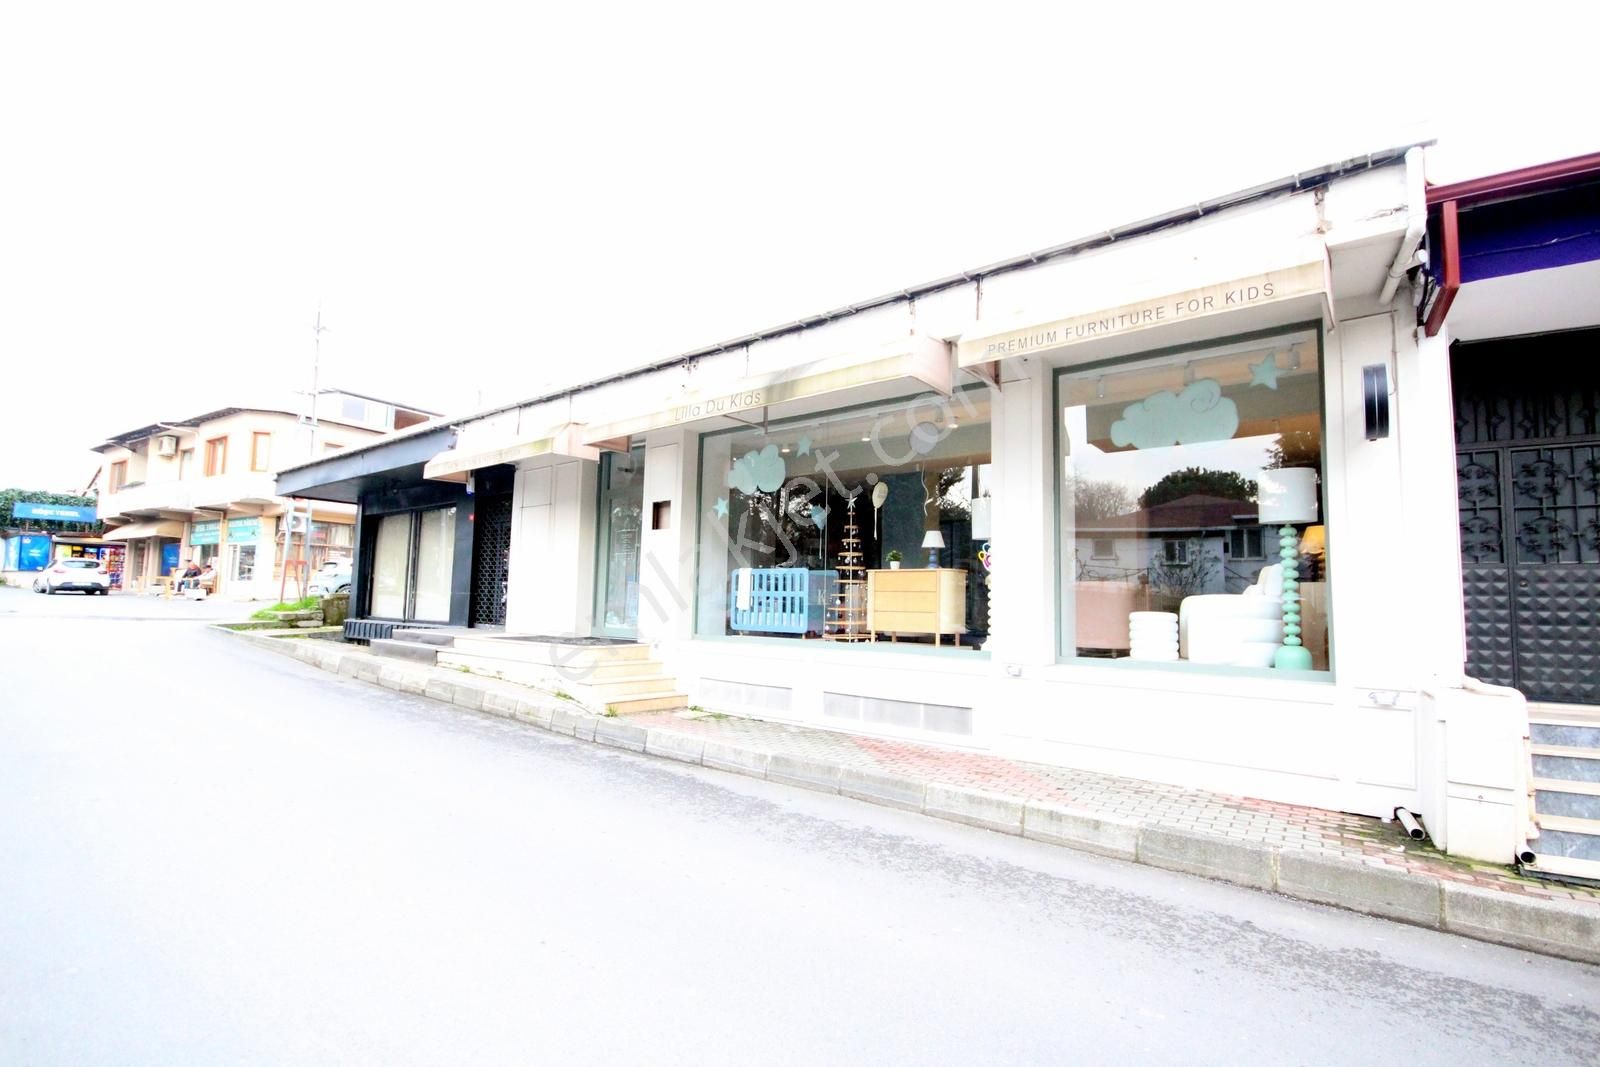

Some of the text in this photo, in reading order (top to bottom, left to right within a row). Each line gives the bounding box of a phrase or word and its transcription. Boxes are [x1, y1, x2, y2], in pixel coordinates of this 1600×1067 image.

[988, 282, 1274, 354] PREMIUM FURNITURE FOR KIDS
[705, 399, 725, 414] Du
[730, 389, 761, 409] Kids
